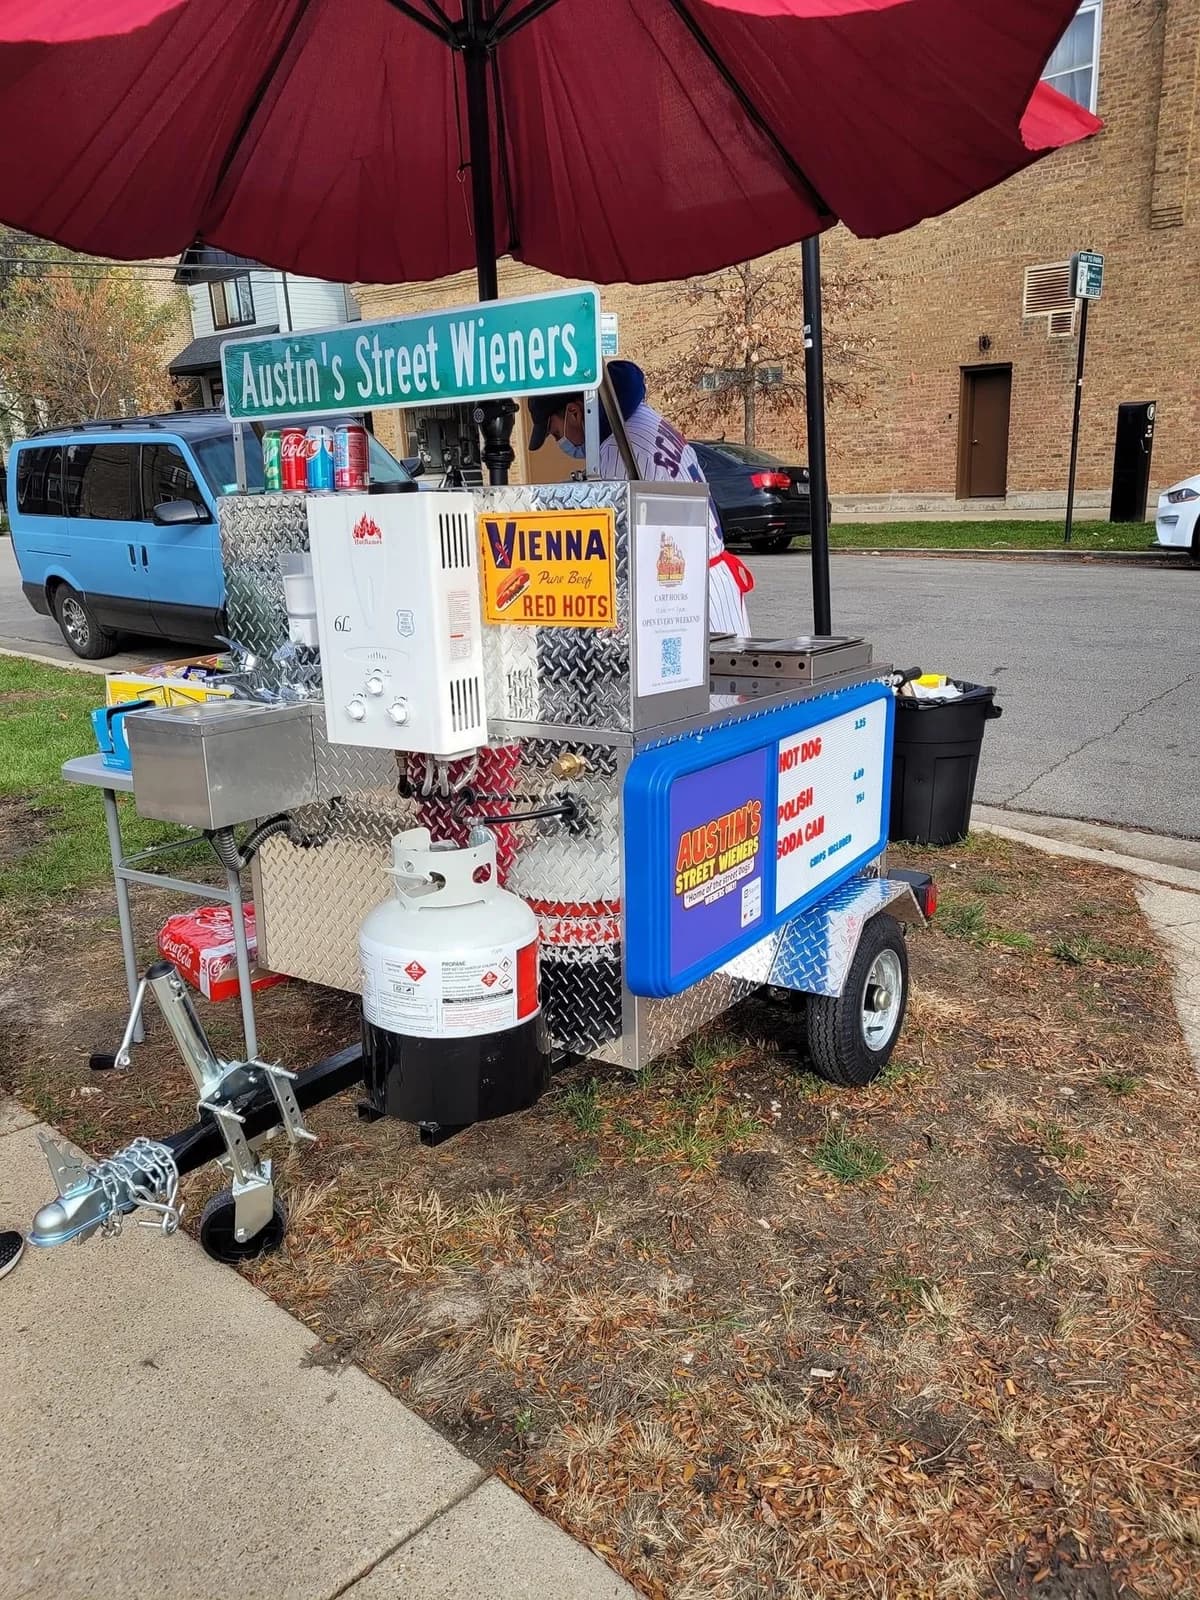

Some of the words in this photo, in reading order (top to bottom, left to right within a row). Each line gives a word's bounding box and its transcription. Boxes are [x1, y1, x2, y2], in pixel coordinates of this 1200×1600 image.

[241, 341, 345, 409] Austin's
[355, 325, 440, 399] Street
[449, 317, 577, 388] Wieners
[485, 522, 607, 569] VIENNA
[538, 570, 564, 584] Pure
[568, 570, 592, 589] Beef
[334, 615, 351, 632] 6L
[523, 595, 556, 617] RED
[563, 595, 608, 617] HOTS
[778, 746, 800, 773] HOT
[801, 737, 822, 763] DOG
[777, 787, 813, 825] POLISH
[676, 800, 761, 872] AUSTIN'S
[776, 828, 803, 860] SODA
[804, 815, 825, 842] CAN
[810, 850, 827, 868] CHIPS
[828, 834, 852, 857] INCLUDED
[675, 858, 716, 895] STREET
[718, 836, 759, 873] WIENERS
